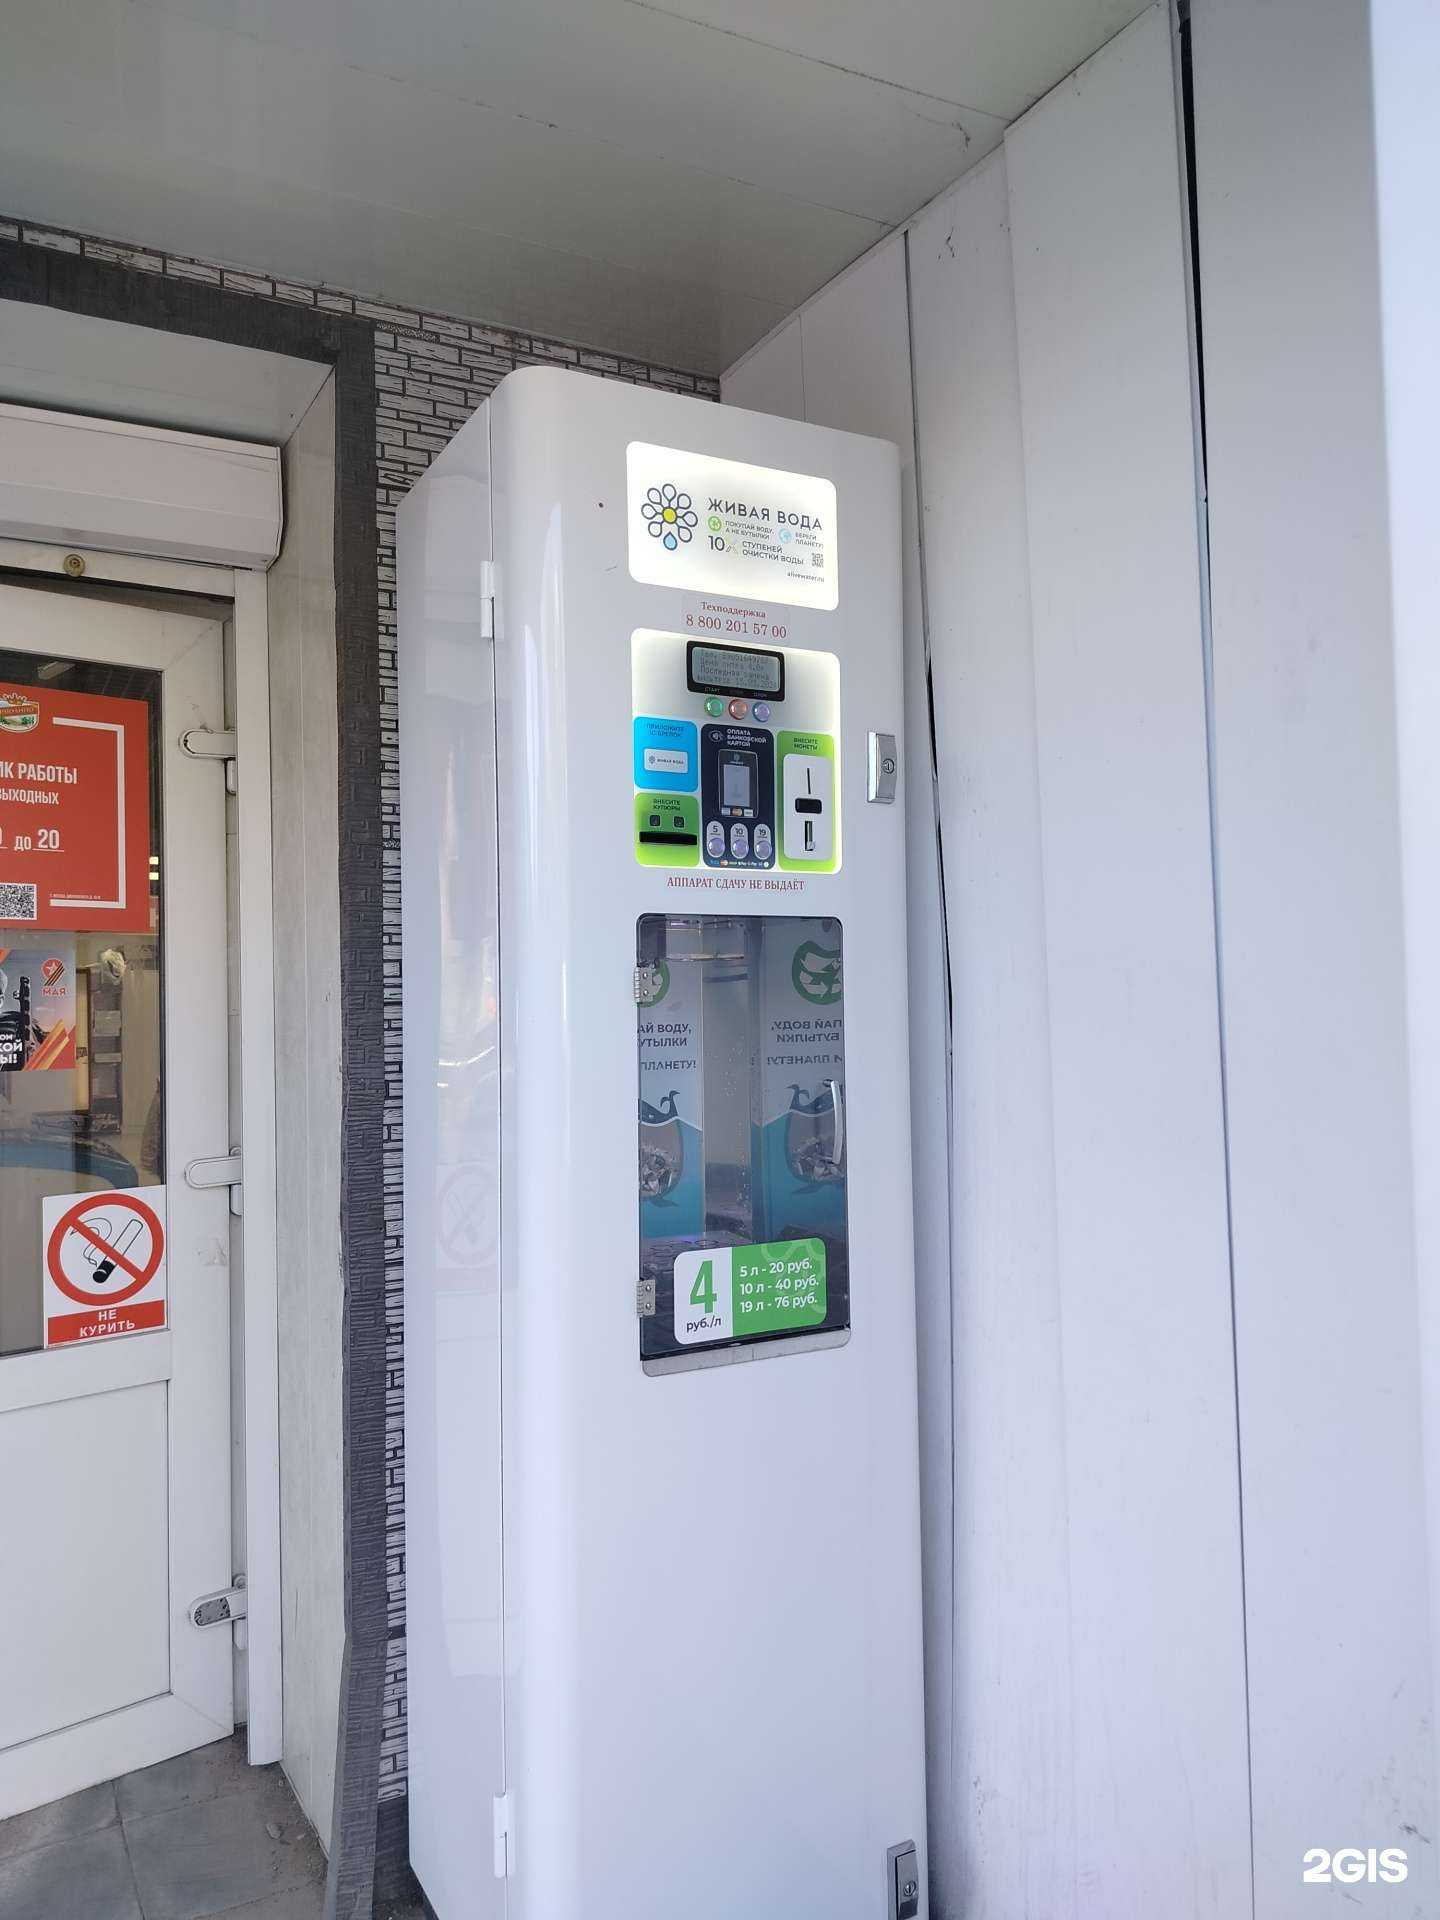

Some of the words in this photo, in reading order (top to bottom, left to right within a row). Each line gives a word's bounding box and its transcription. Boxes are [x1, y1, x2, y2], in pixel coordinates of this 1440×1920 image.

[708, 497, 770, 521] ЖИВАЯ
[777, 511, 822, 530] ВОДА
[725, 521, 755, 531] ПОКУПАЙ
[708, 535, 725, 551] 10
[740, 530, 770, 540] БУТЫЛКИ
[742, 541, 783, 553] СТУПЕНЕЙ
[742, 549, 779, 561] ОЧИСТКИ
[781, 556, 804, 565] ВОДЫ
[701, 602, 766, 618] Техподдержка
[686, 614, 694, 627] 8
[698, 616, 722, 630] 800
[726, 620, 749, 634] 201
[753, 624, 768, 636] 57
[772, 625, 787, 638] 00
[727, 729, 751, 737] ОПЛАТА
[727, 735, 767, 744] БАНКОВСКОЙ
[793, 737, 818, 745] ВНЕСИТЕ
[727, 740, 751, 748] КАРТОЙ
[18, 762, 78, 784] РАБОТЫ
[0, 788, 60, 805] ЫХОДНЫХ
[713, 825, 718, 833] 5
[735, 827, 744, 835] 10
[14, 835, 32, 851] до
[37, 829, 60, 849] 20
[667, 877, 713, 888] АППАРАТ
[715, 878, 746, 889] СДАЧУ
[749, 879, 763, 889] НЕ
[765, 879, 805, 891] ВЫДАЁТ
[41, 986, 67, 996] МАЯ
[657, 1023, 692, 1035] ВОДУ,
[740, 1266, 747, 1277] 5
[750, 1267, 759, 1276] л
[769, 1261, 784, 1273] 20
[787, 1257, 813, 1275] руб.
[689, 1260, 718, 1314] 4
[740, 1283, 753, 1295] 10
[755, 1284, 764, 1293] л
[775, 1278, 792, 1291] 40
[794, 1275, 819, 1292] руб.
[741, 1300, 753, 1313] 19
[755, 1301, 764, 1310] л
[775, 1296, 790, 1308] 76
[792, 1293, 818, 1310] руб.
[98, 1308, 117, 1321] НЕ
[79, 1319, 135, 1338] КУРИТЬ
[686, 1315, 722, 1332] руб./л
